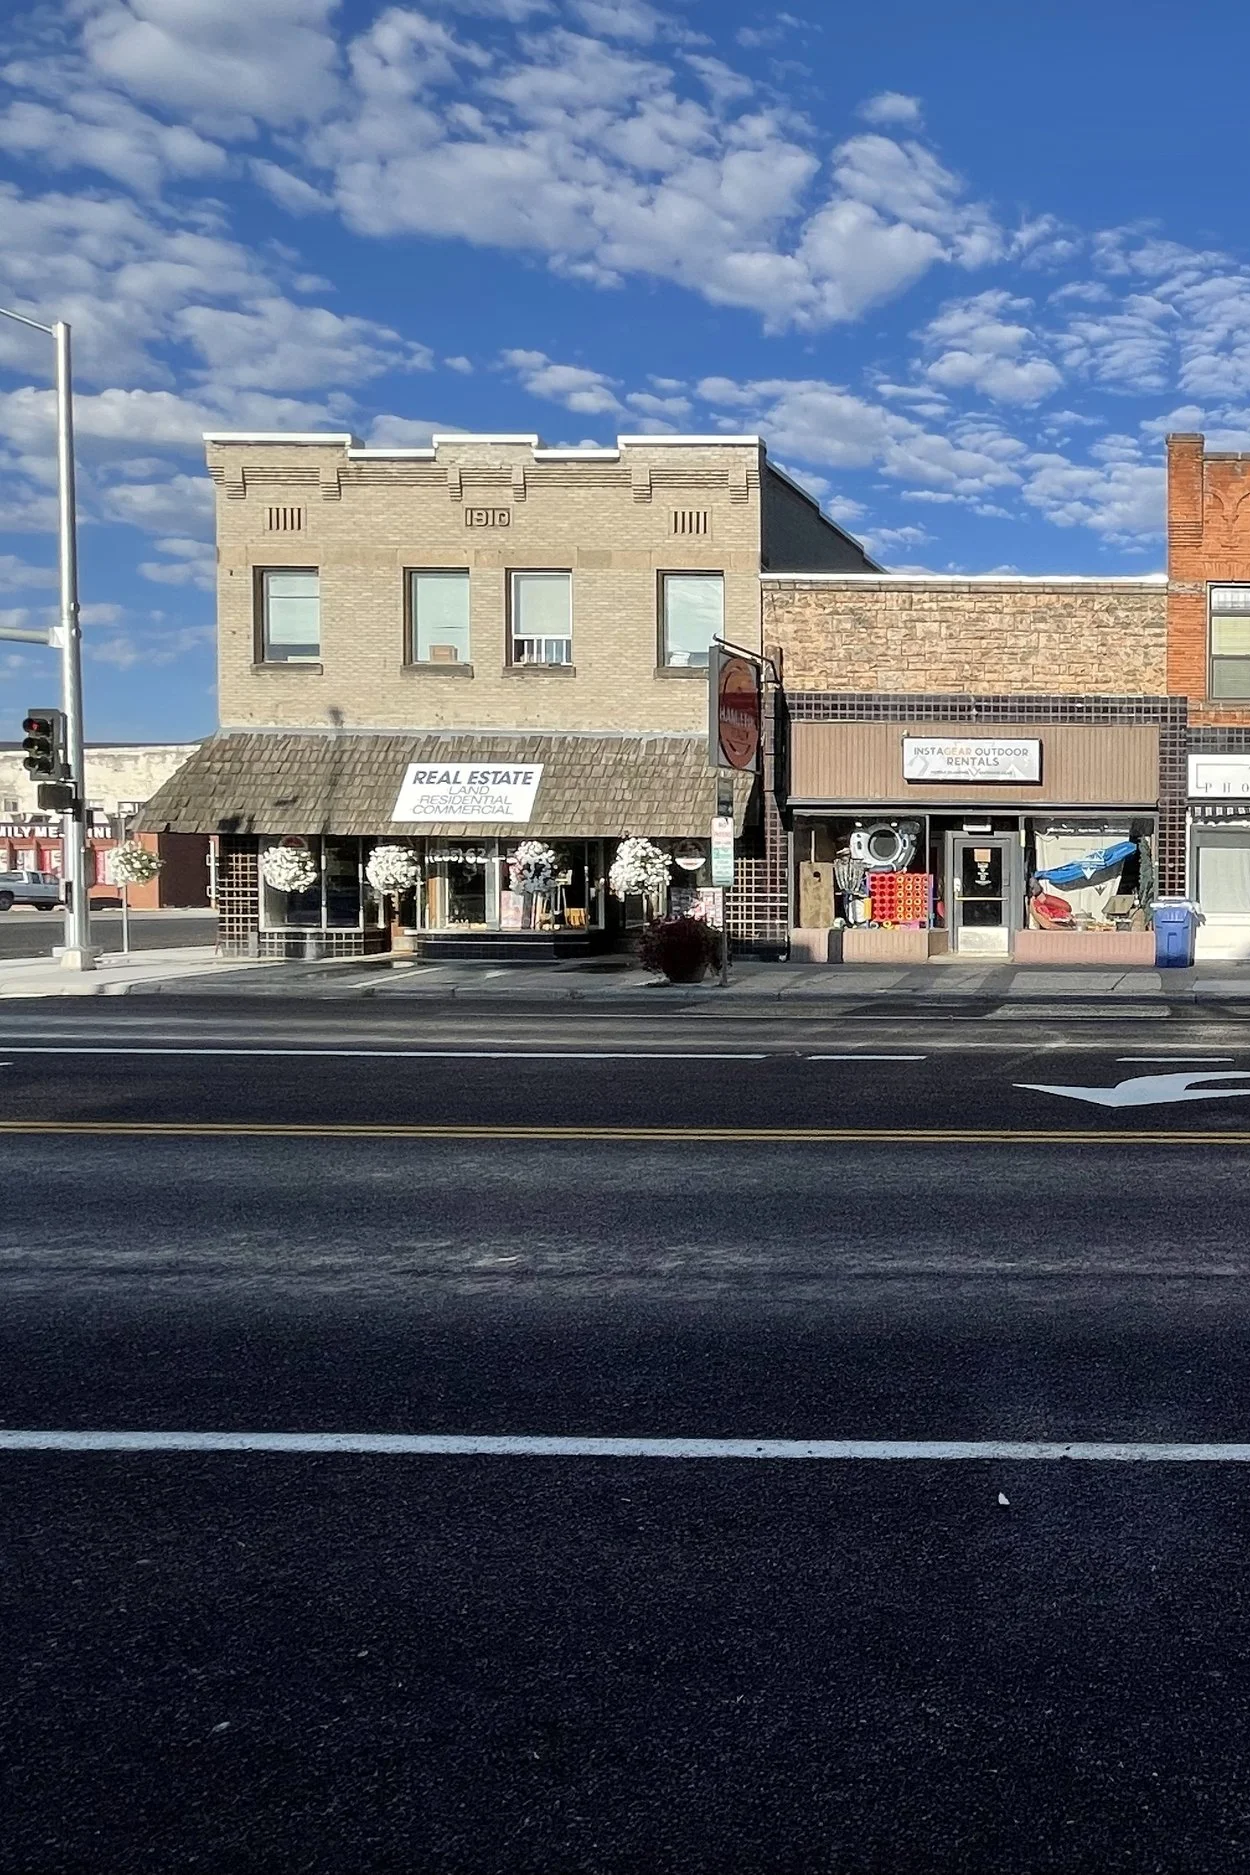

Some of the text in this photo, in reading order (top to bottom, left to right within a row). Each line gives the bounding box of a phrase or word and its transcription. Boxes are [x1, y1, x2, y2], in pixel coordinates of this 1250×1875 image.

[466, 508, 511, 527] 1910
[914, 747, 1029, 756] INSTAGEAR OUTDOOR
[946, 757, 1000, 767] RENTALS
[412, 770, 534, 785] REAL ESTATE
[448, 785, 490, 795] LAND
[418, 795, 513, 805] RESIDENTIAL
[412, 805, 514, 815] COMMERCIAL
[35, 826, 112, 838] MEINE
